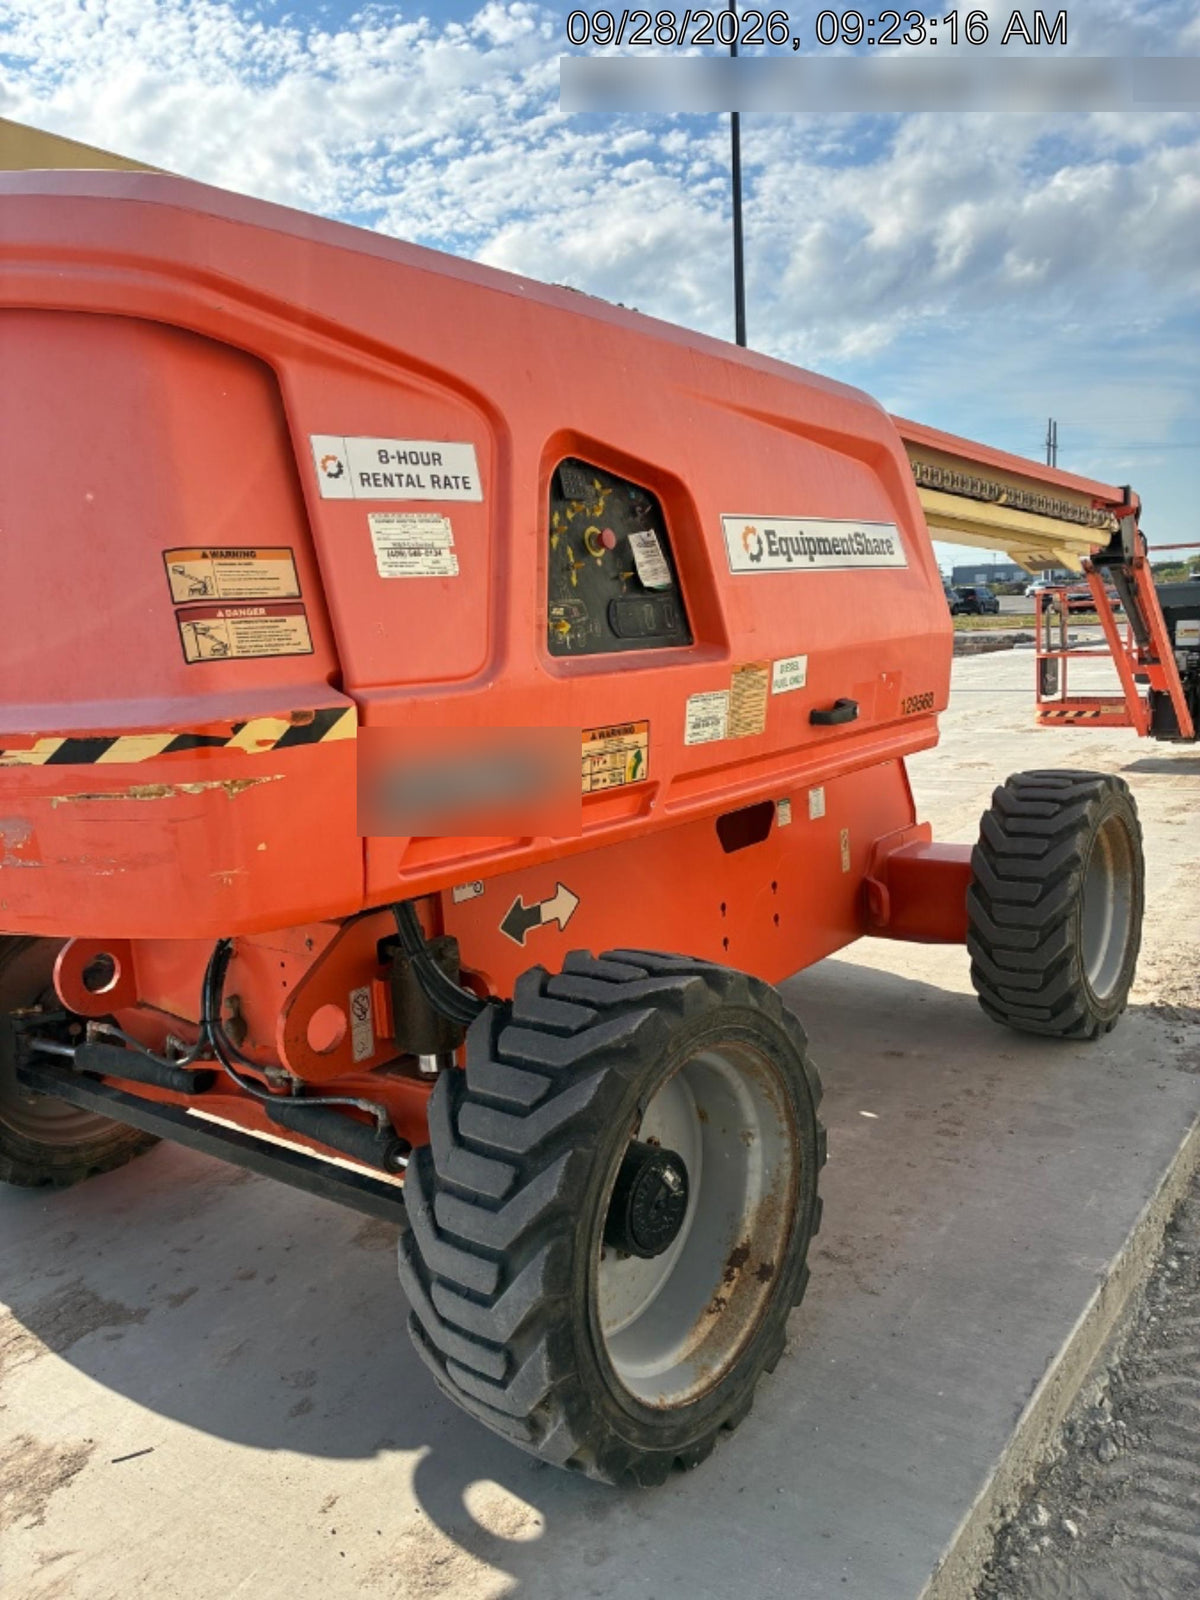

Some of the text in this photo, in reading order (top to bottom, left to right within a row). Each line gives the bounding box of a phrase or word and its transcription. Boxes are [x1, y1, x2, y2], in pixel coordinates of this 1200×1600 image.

[377, 449, 443, 466] 8-HOUR
[359, 472, 472, 490] RENTAL RATE
[764, 529, 895, 562] EquipmentShare
[210, 550, 257, 559] WARNING
[225, 607, 267, 617] DANGER
[780, 661, 800, 674] DIESEL
